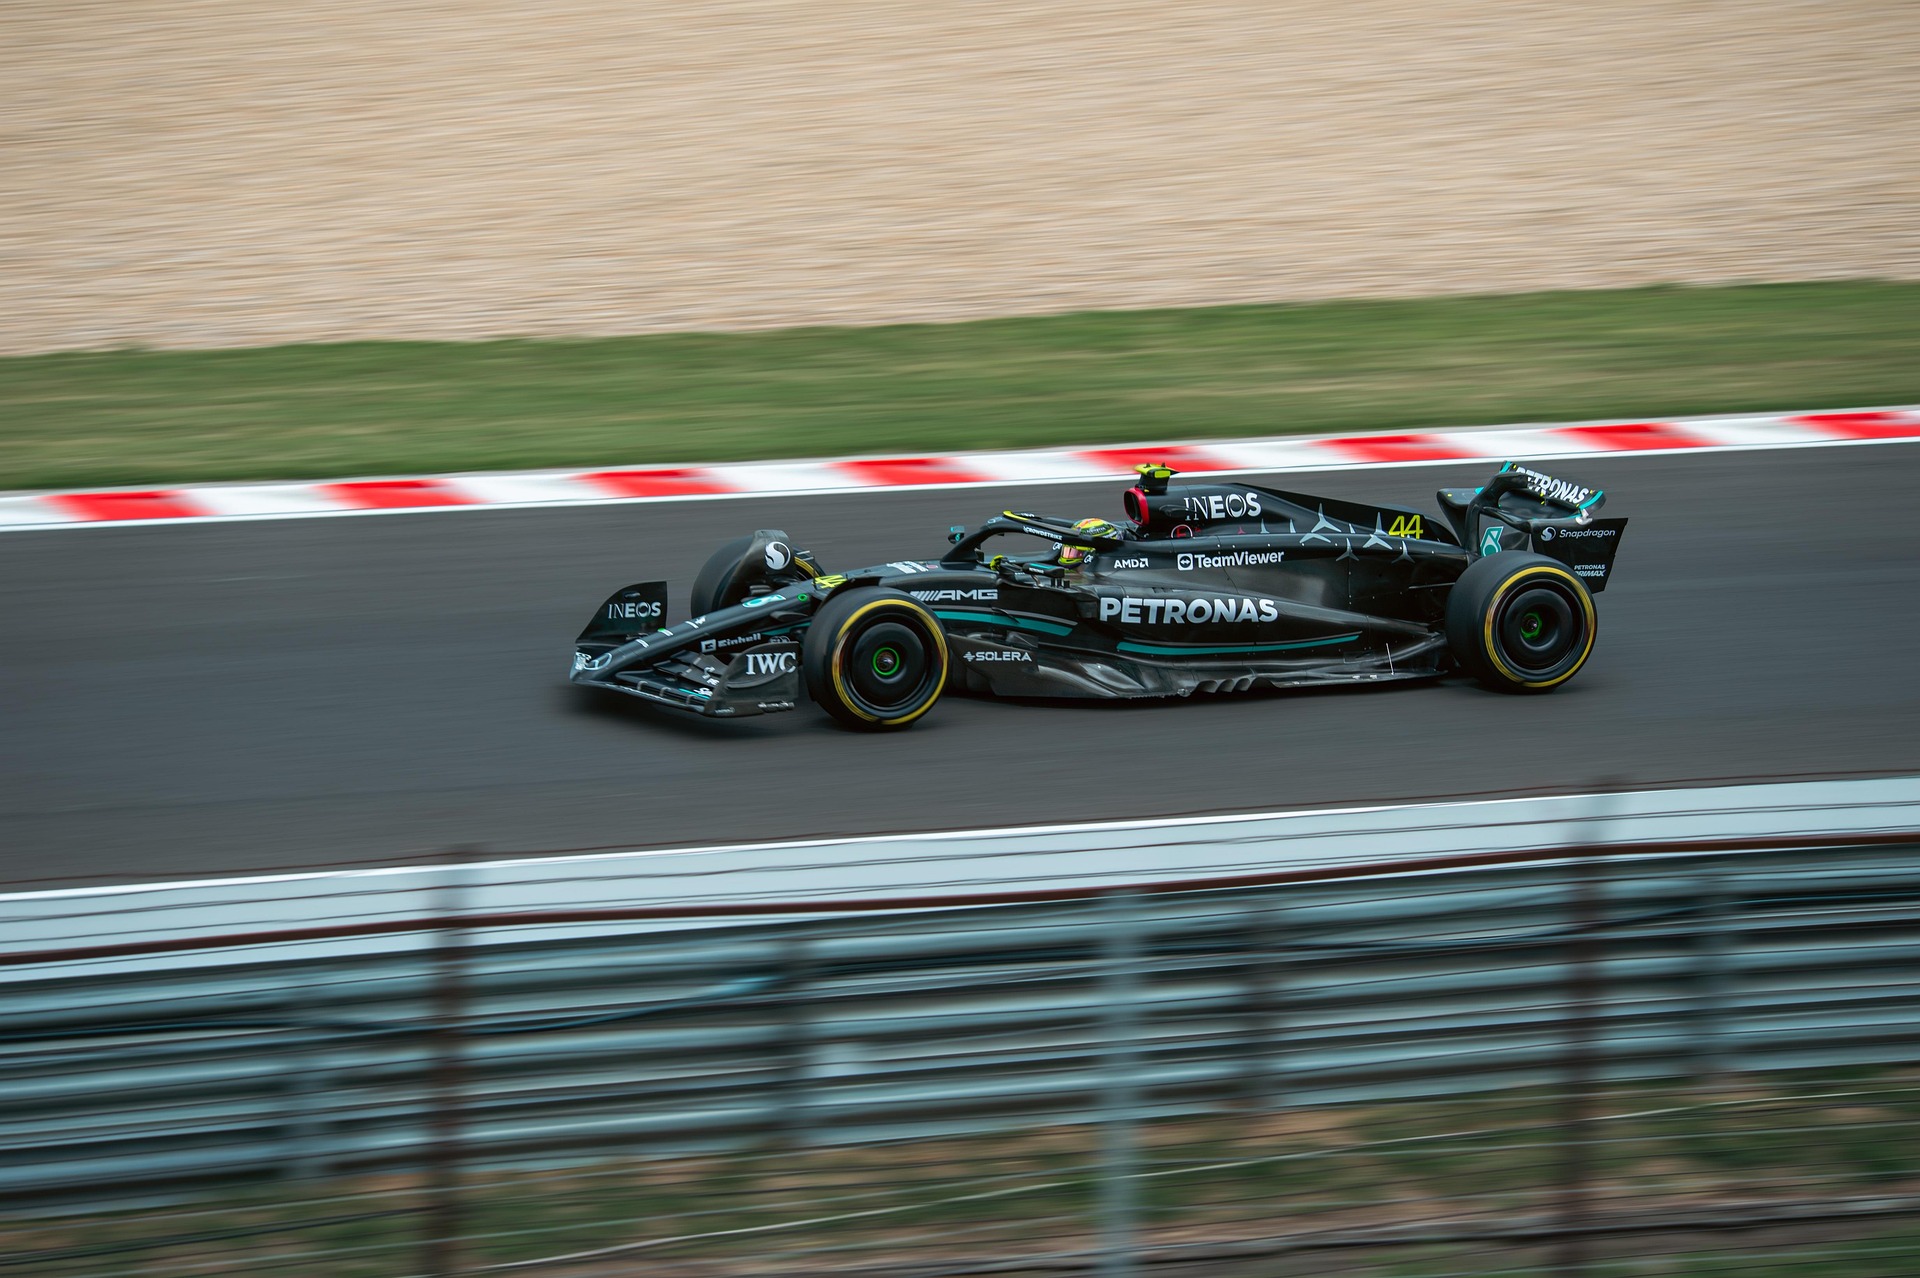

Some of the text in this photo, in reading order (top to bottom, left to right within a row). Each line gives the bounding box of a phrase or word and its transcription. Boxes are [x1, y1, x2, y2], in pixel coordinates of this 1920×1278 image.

[1184, 492, 1262, 521] INEOS
[1388, 515, 1423, 539] 44
[1559, 529, 1616, 539] Snapdragon
[1114, 558, 1139, 569] AMD
[1194, 551, 1284, 569] TeamViewer
[934, 589, 998, 601] AMG
[608, 601, 662, 619] INEOS
[1100, 597, 1278, 624] PETRONAS
[718, 633, 761, 648] Einhell
[745, 652, 796, 675] IWC
[975, 651, 1032, 662] SOLERA
